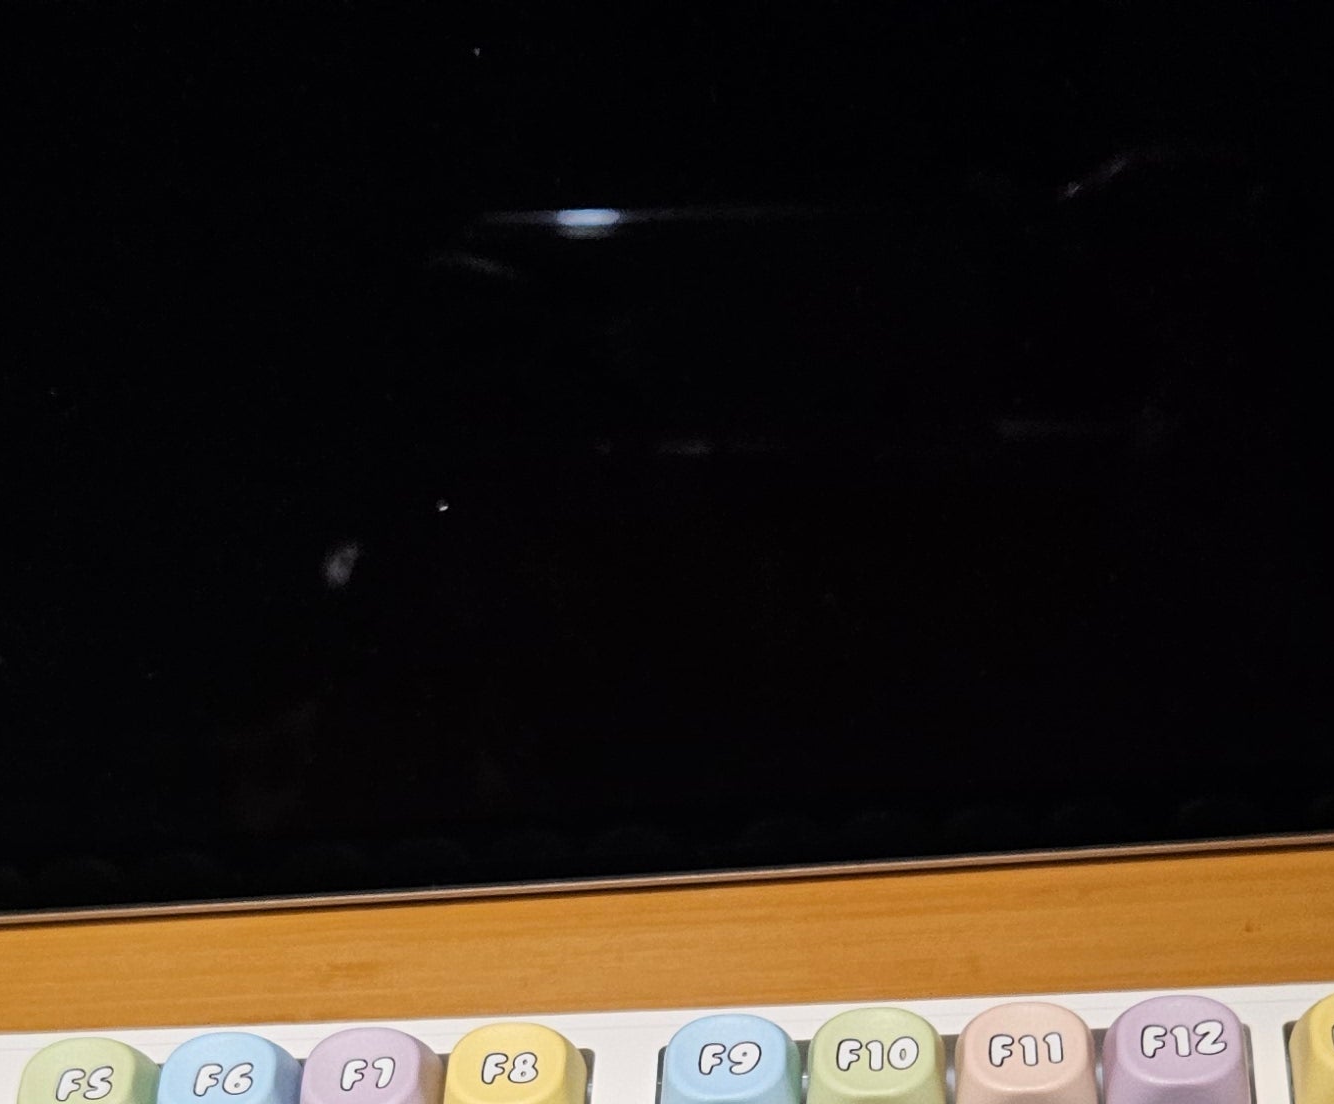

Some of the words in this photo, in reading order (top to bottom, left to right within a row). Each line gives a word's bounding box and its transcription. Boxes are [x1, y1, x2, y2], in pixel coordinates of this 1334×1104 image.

[698, 1040, 763, 1076] F9
[836, 1036, 920, 1072] F10
[988, 1031, 1064, 1067] F11
[1140, 1020, 1229, 1060] F12
[55, 1065, 114, 1102] F5
[193, 1062, 254, 1097] F6
[340, 1056, 396, 1091] F7
[481, 1051, 539, 1085] F8
